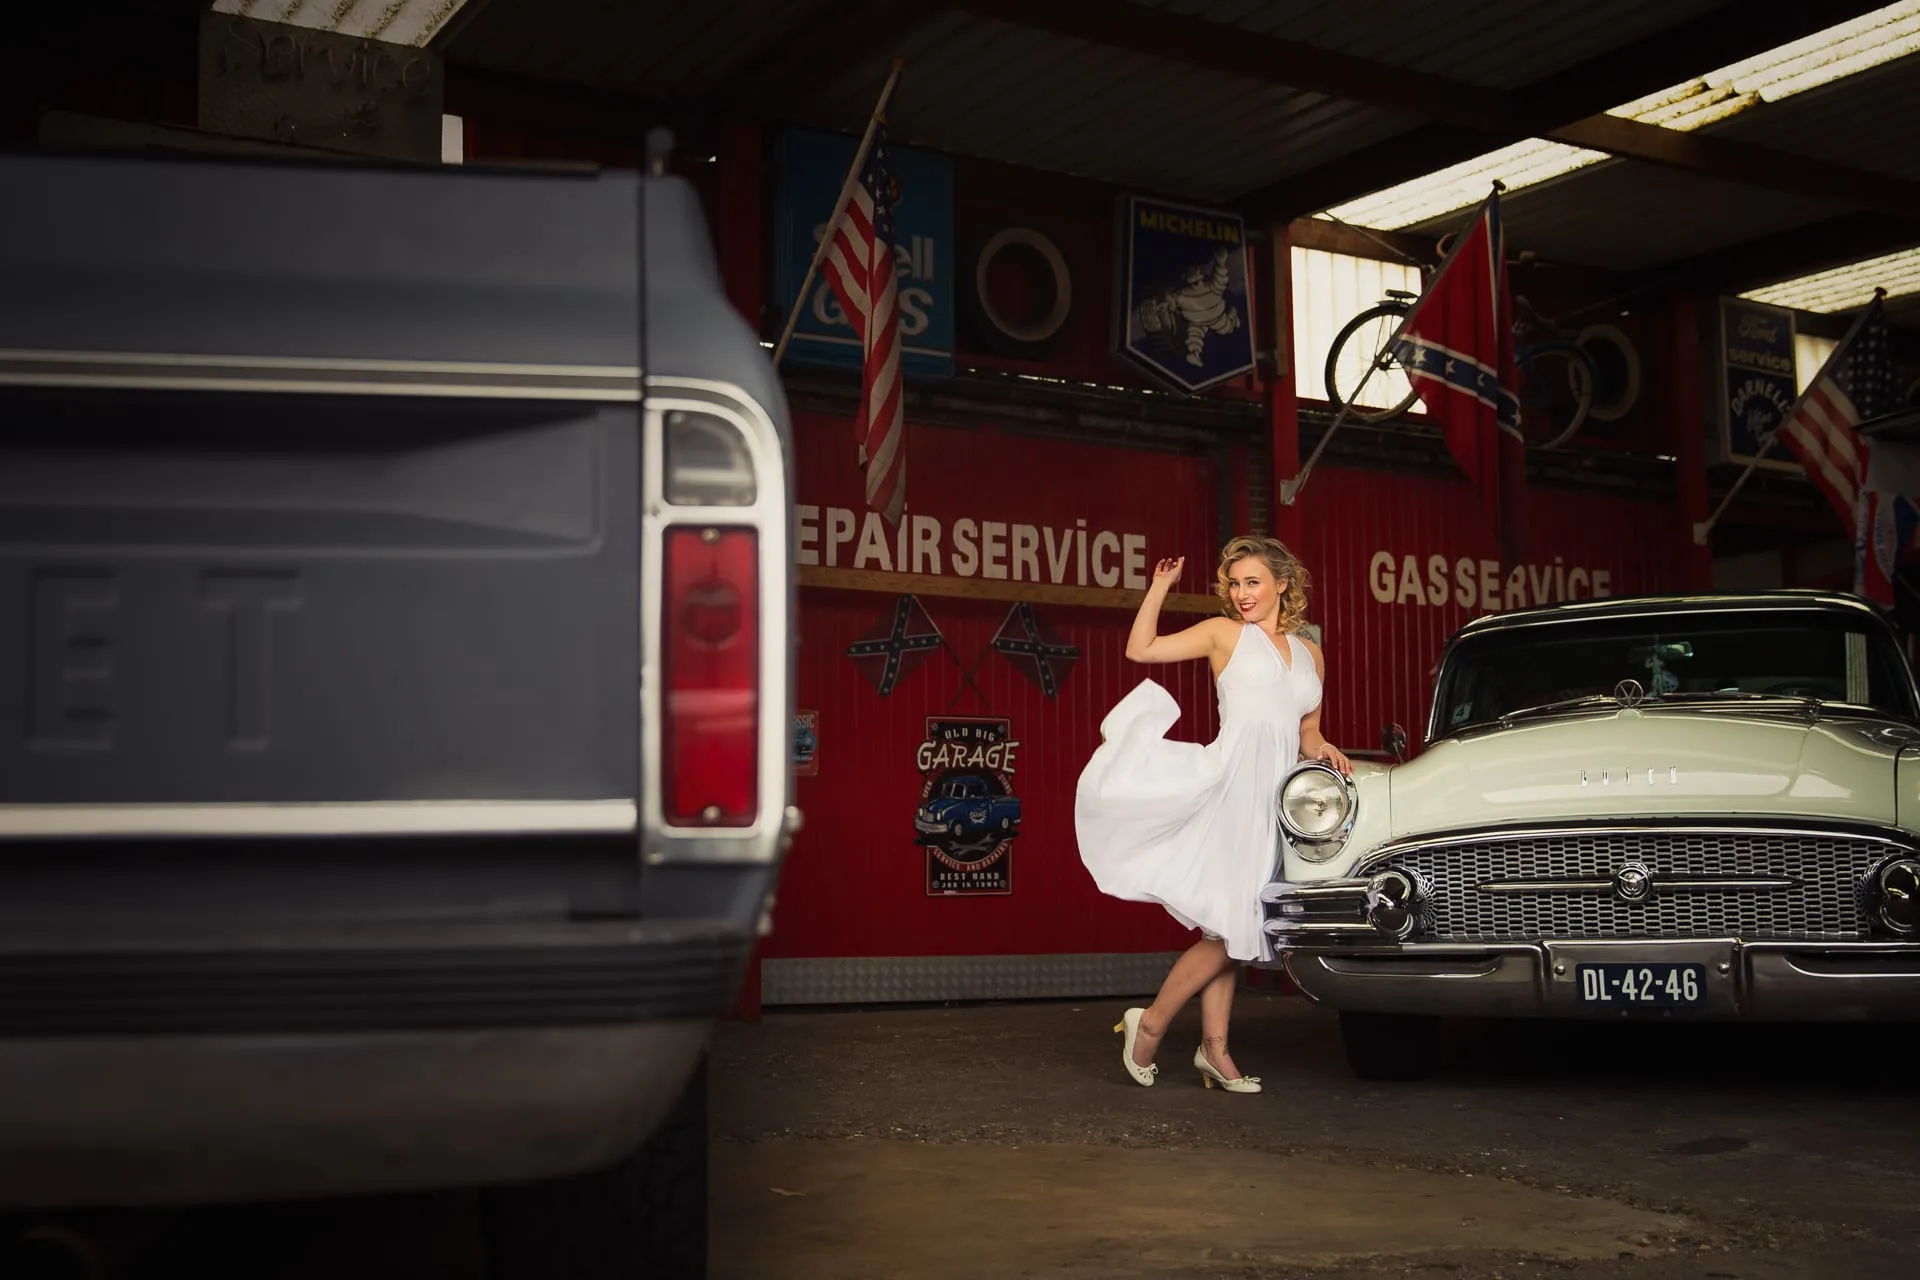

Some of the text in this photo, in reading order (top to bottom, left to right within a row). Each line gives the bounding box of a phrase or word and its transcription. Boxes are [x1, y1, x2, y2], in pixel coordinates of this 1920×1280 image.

[1139, 208, 1240, 244] MICHELIN
[812, 278, 934, 337] GS
[1728, 347, 1792, 372] service
[1369, 550, 1449, 607] GAS
[944, 727, 996, 742] OLD BIG
[917, 740, 1020, 773] GARAGE
[1582, 967, 1699, 1001] DL-42-46
